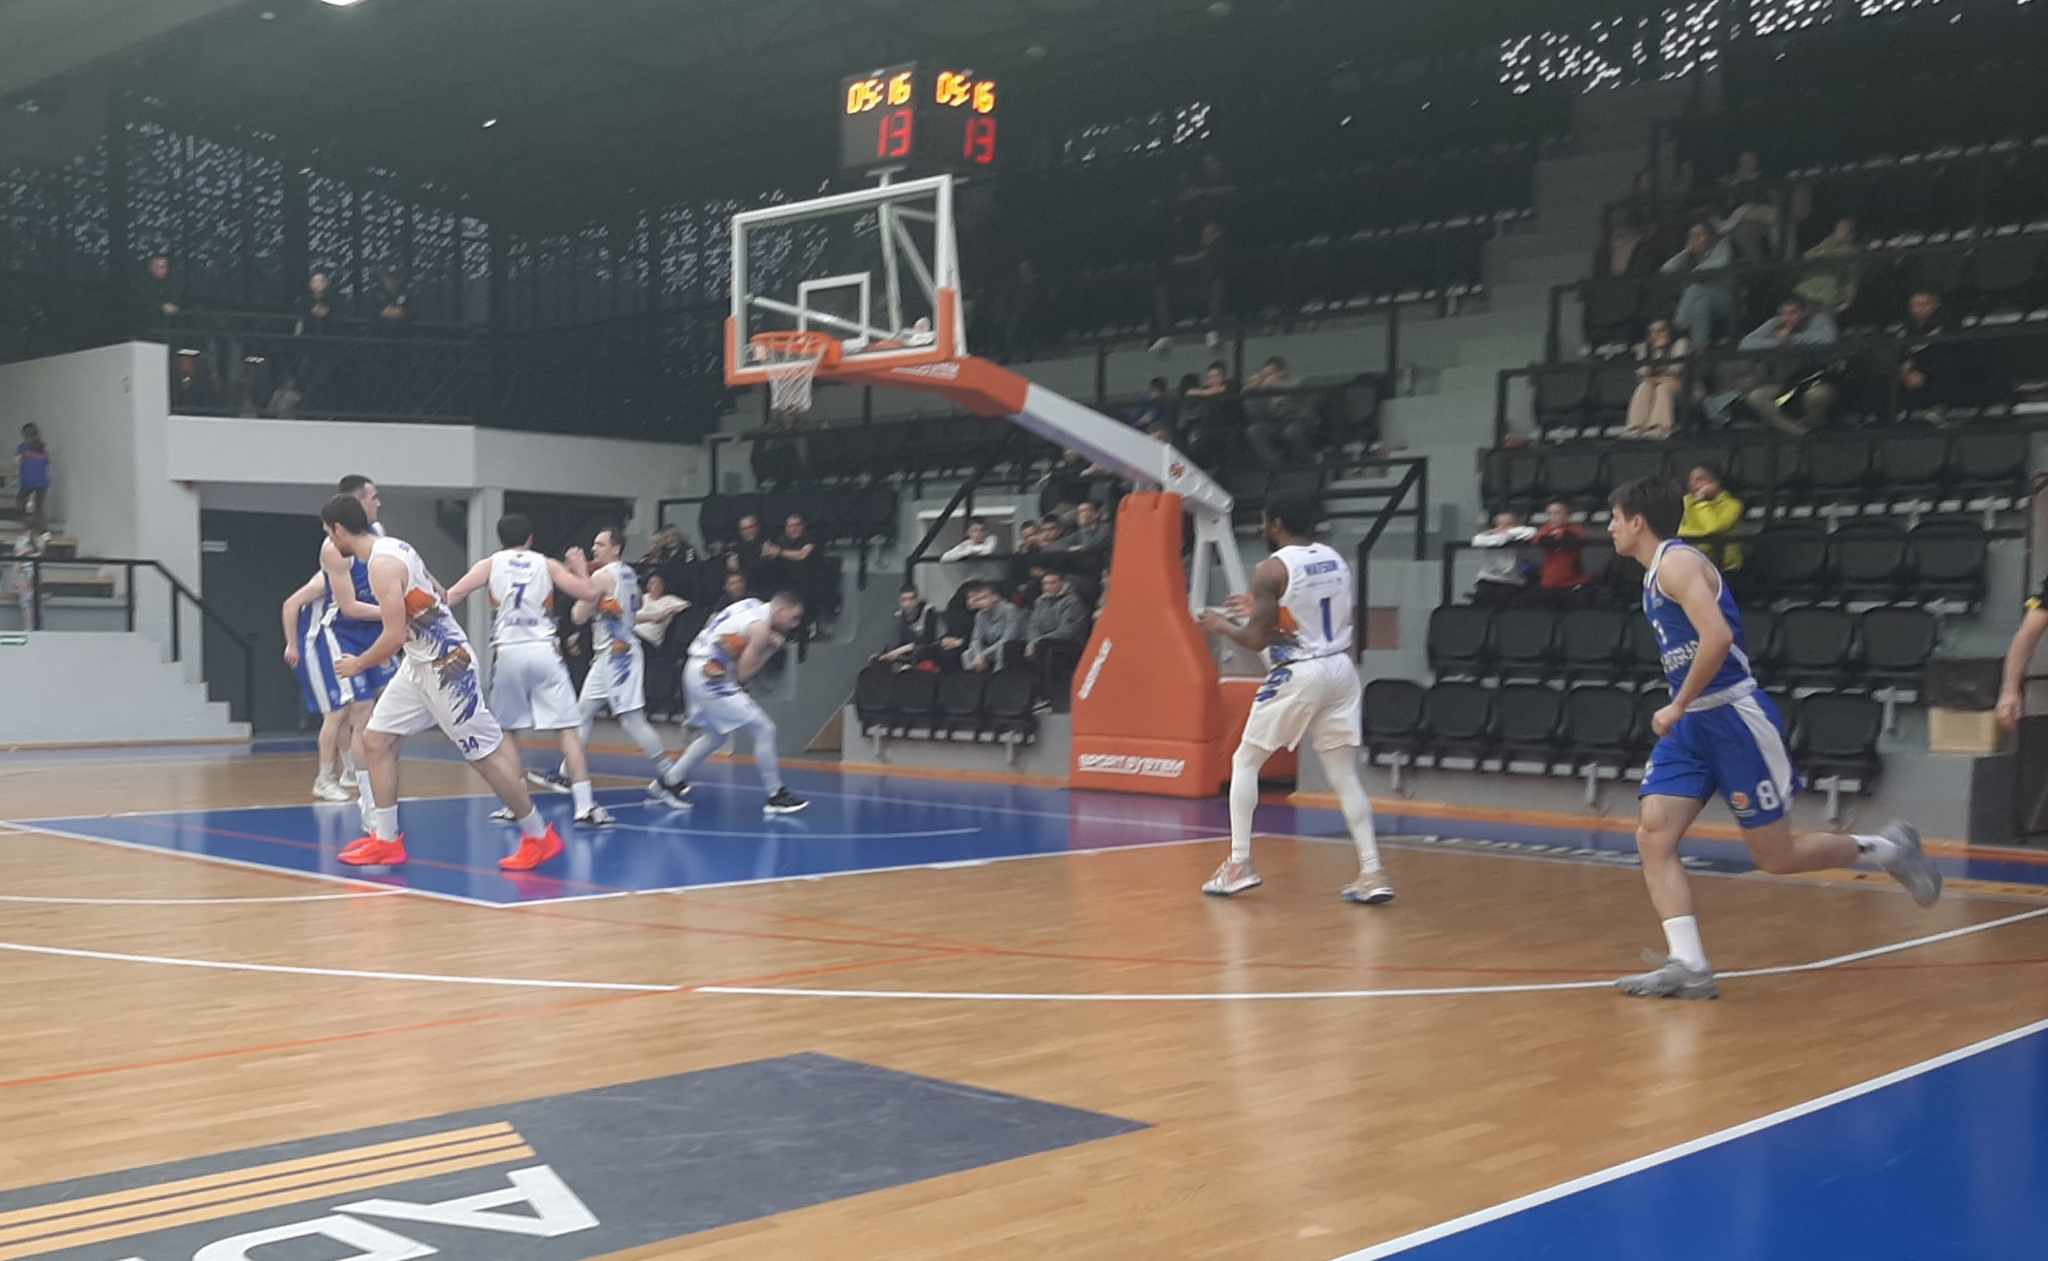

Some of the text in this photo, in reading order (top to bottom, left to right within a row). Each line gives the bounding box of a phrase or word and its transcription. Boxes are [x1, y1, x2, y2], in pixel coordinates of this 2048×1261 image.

[878, 108, 912, 159] 13
[964, 117, 996, 164] 13
[512, 582, 527, 608] 7
[1320, 597, 1333, 642] 1
[459, 736, 479, 753] 34
[1756, 780, 1779, 811] 8
